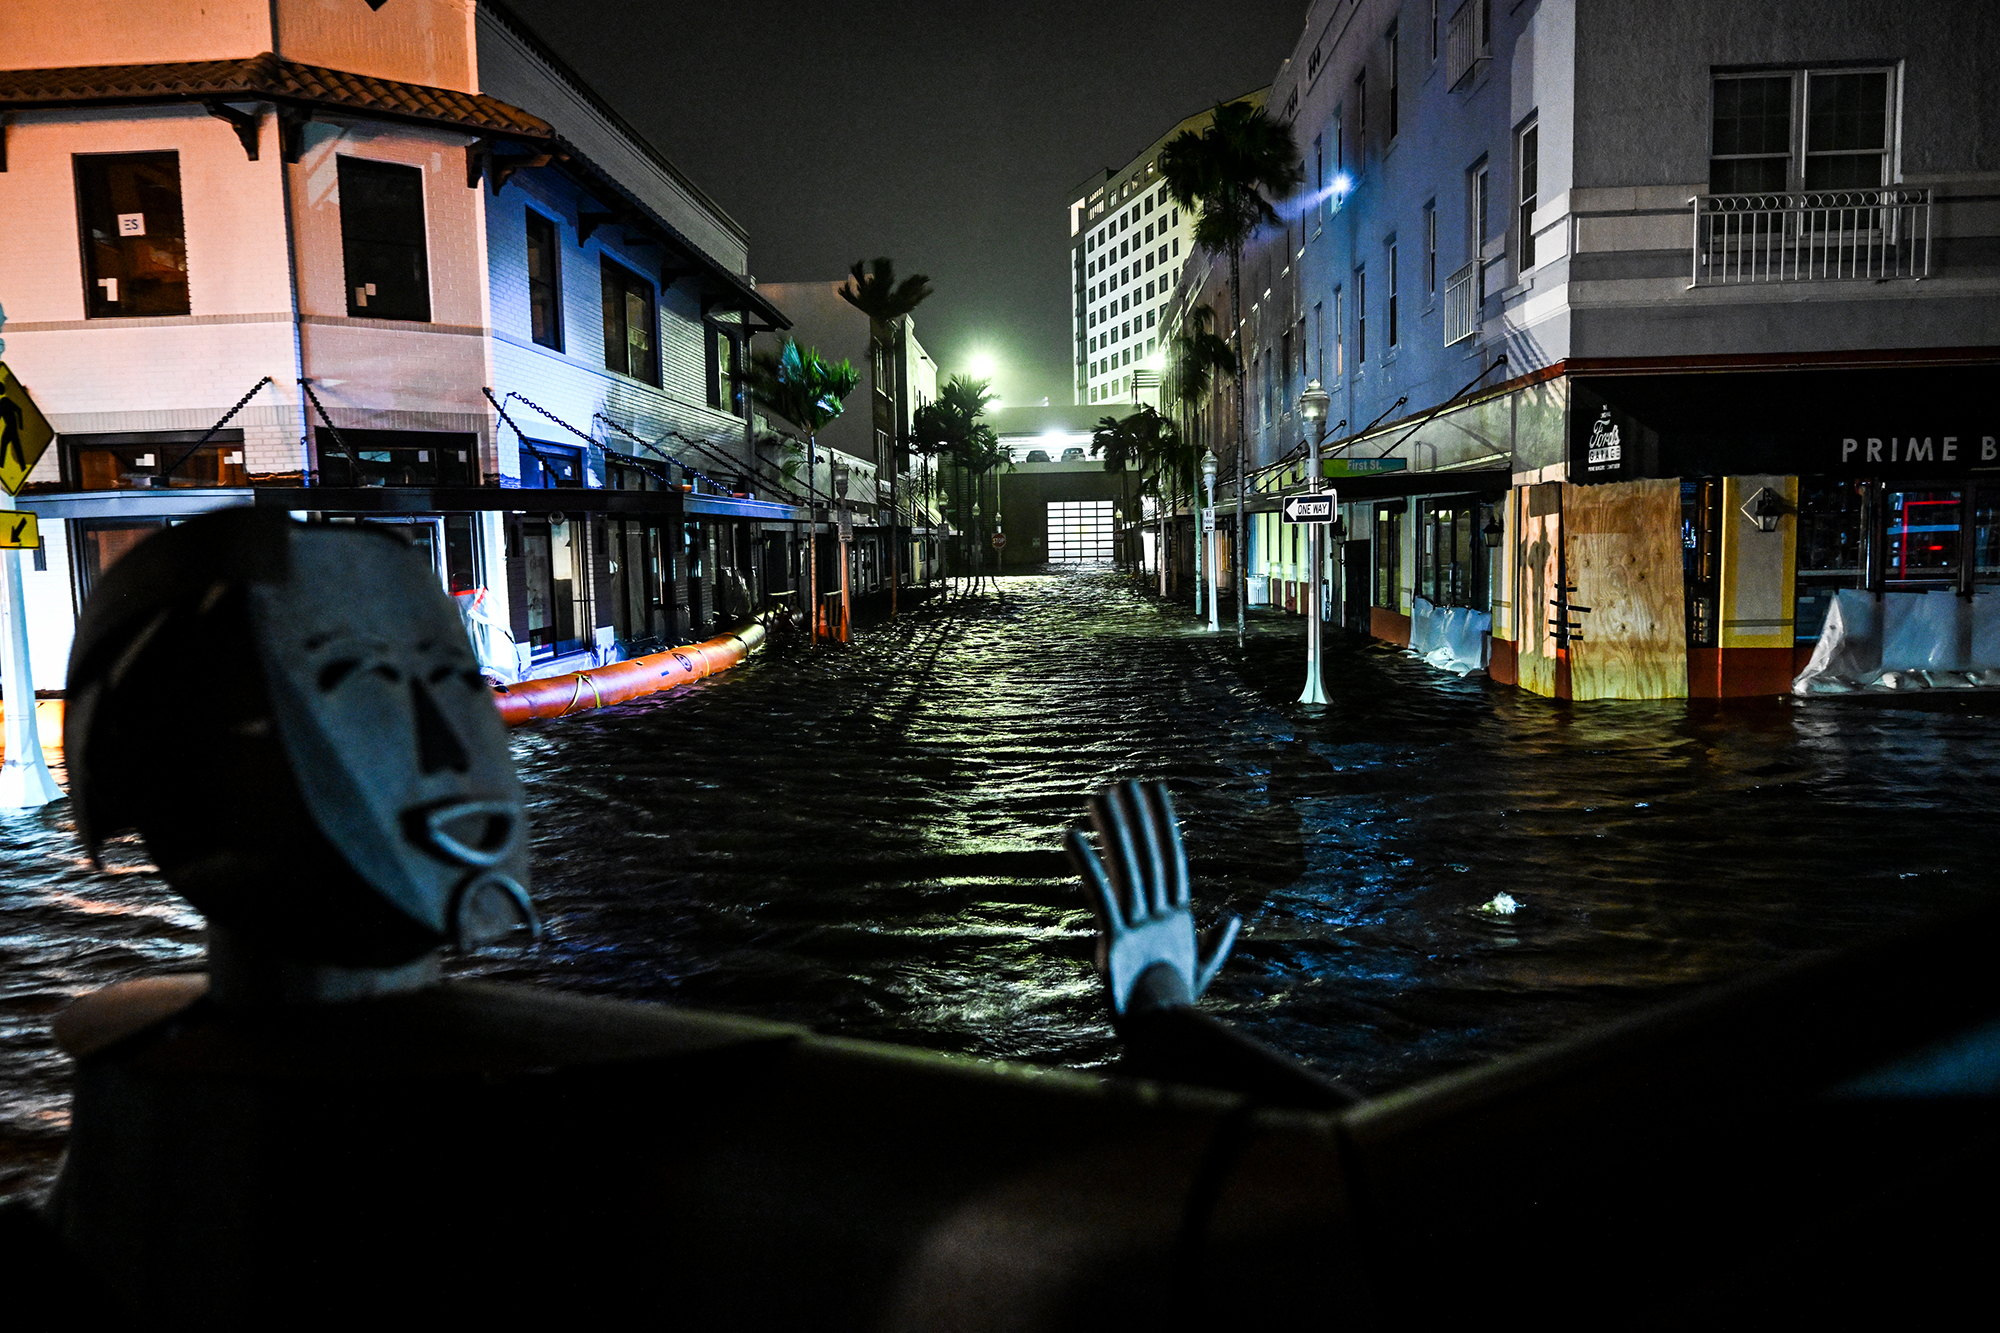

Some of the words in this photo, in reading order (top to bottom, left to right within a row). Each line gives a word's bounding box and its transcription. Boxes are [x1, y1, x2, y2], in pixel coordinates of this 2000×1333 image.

[1589, 448, 1620, 461] GARAGE
[1842, 436, 1958, 462] PRIME
[1347, 460, 1368, 471] First
[1370, 459, 1382, 470] St.
[1298, 504, 1311, 514] ONE
[1313, 503, 1327, 513] WAY
